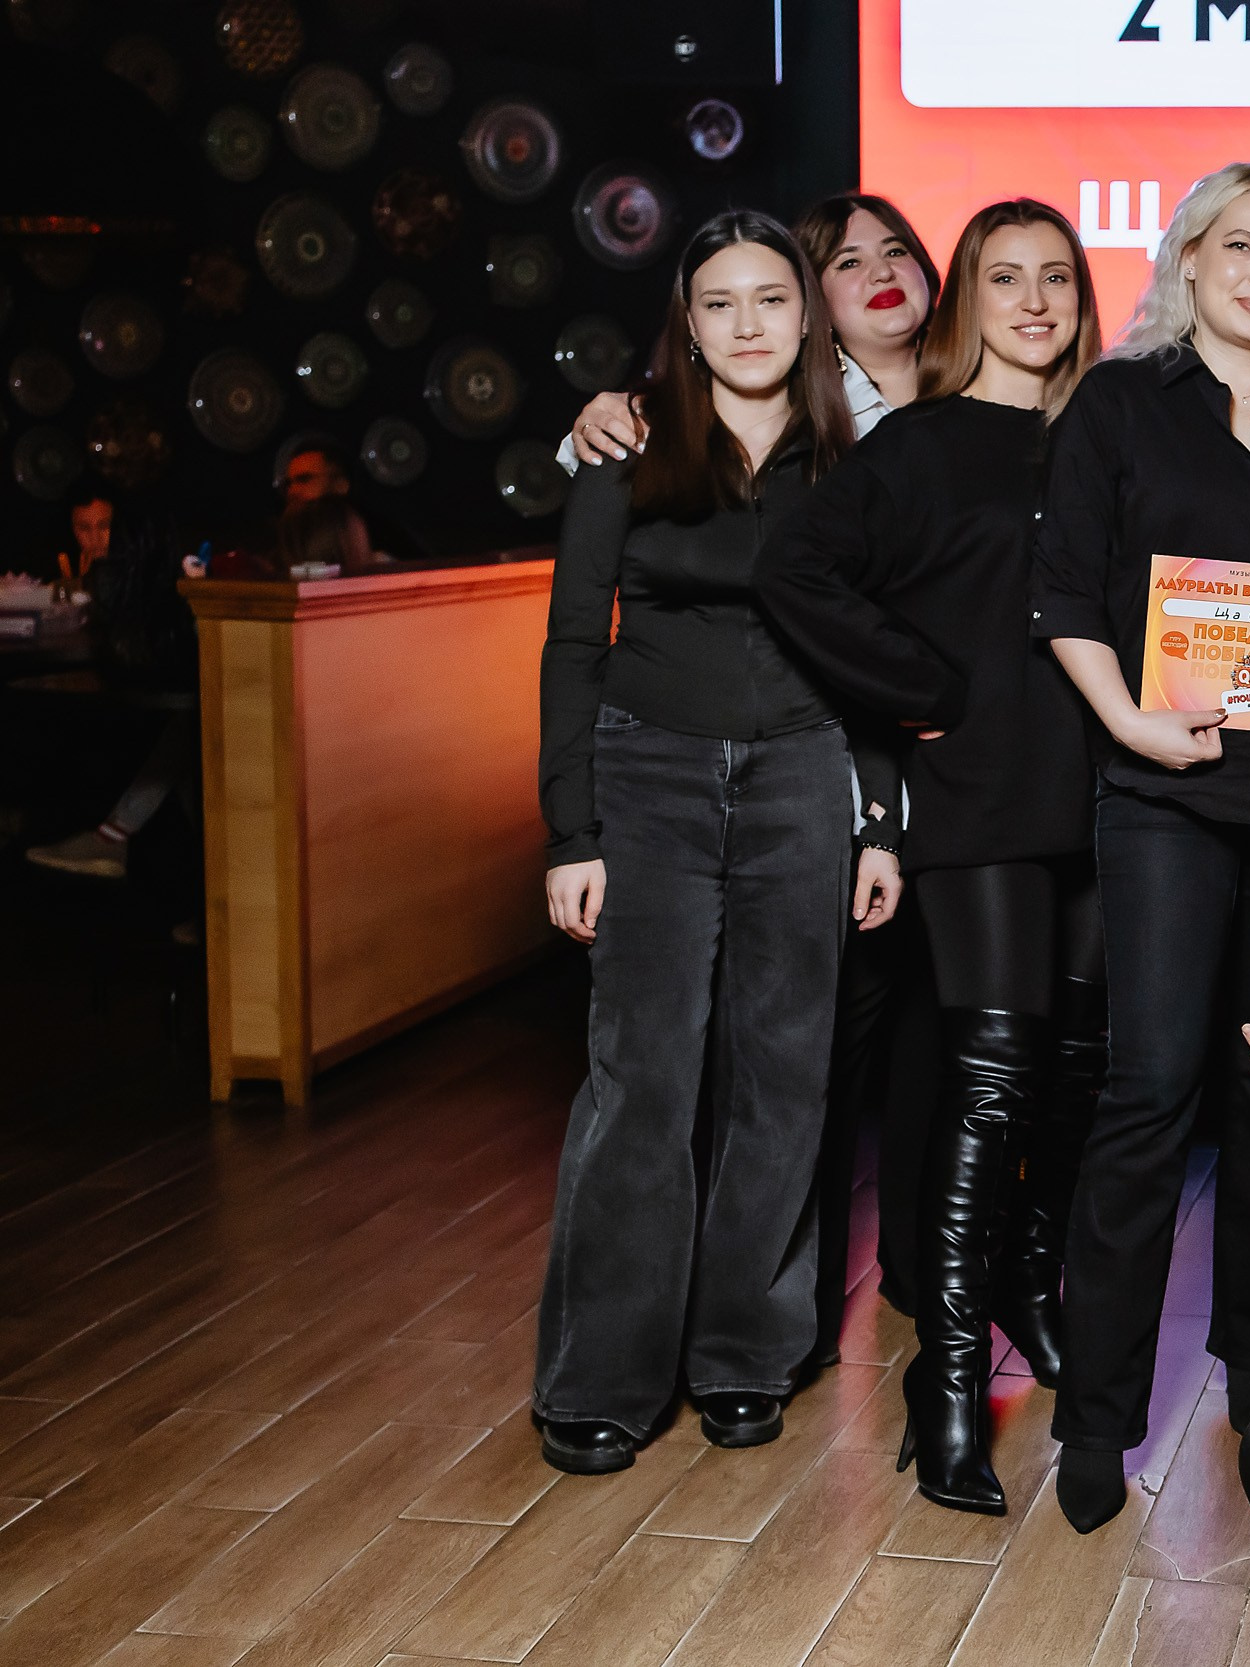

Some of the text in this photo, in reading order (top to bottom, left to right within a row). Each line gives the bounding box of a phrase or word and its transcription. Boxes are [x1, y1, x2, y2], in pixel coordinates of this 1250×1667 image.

[1118, 0, 1160, 41] 2
[1155, 577, 1238, 595] ЛАУРЕАТЫ
[1215, 607, 1240, 620] Ща
